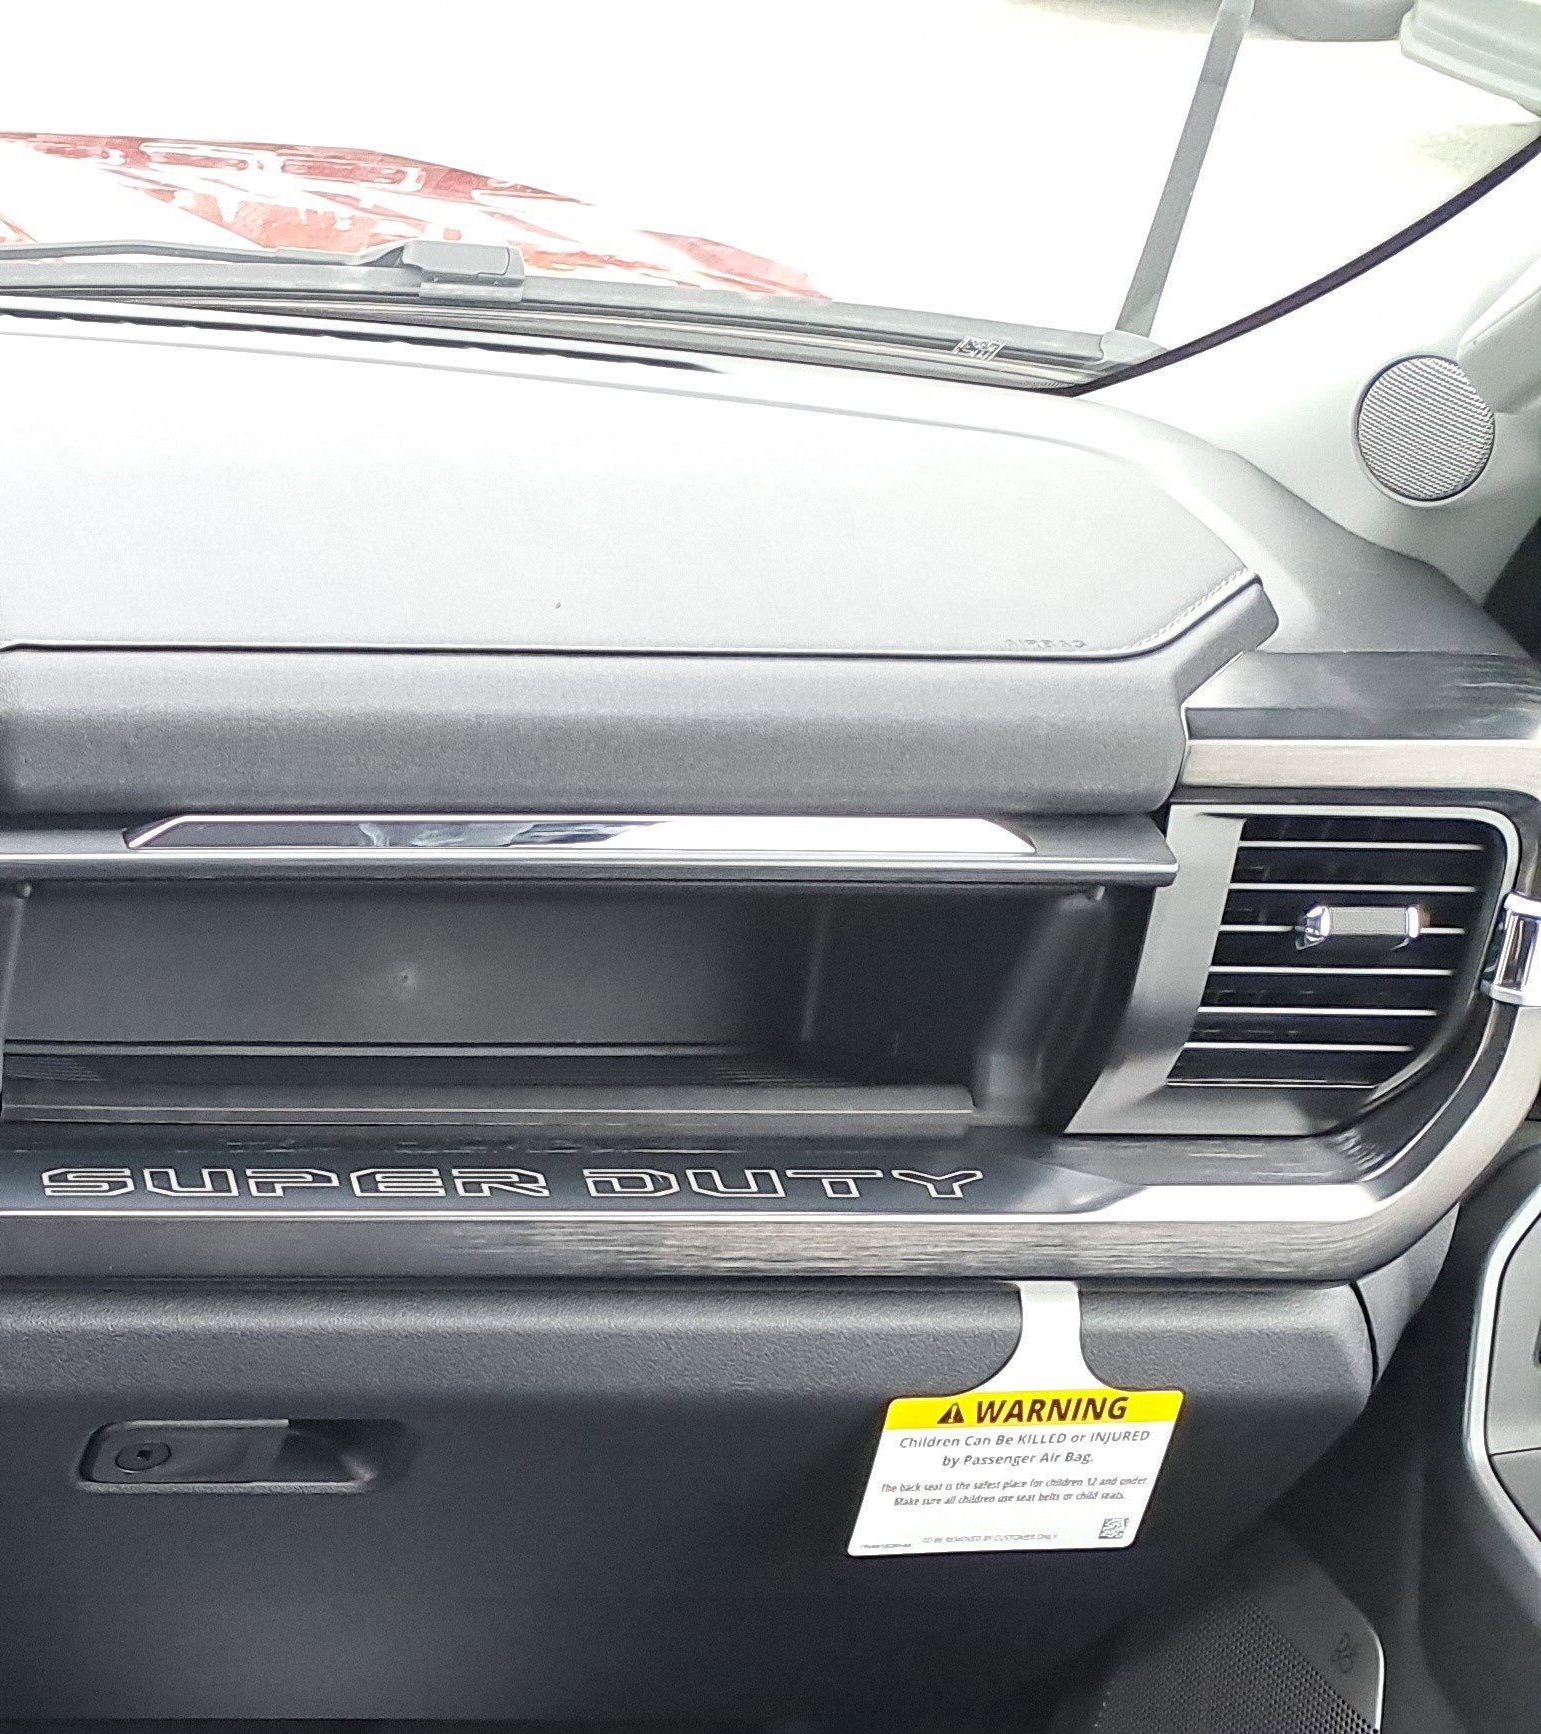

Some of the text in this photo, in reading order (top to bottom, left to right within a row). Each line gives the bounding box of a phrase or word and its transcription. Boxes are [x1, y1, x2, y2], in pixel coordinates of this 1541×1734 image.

[41, 1167, 984, 1199] SUPER DUTY
[976, 1396, 1130, 1424] WARNING
[899, 1430, 1151, 1449] Children Can Be KILLED or INJURED
[942, 1451, 1094, 1468] by Passenger Air Bag.
[881, 1483, 898, 1493] The
[899, 1482, 921, 1492] back
[923, 1483, 943, 1492] seat
[955, 1481, 970, 1491] the
[1002, 1479, 1028, 1490] place
[1045, 1477, 1083, 1487] children
[1099, 1477, 1118, 1486] and
[958, 1494, 996, 1504] children
